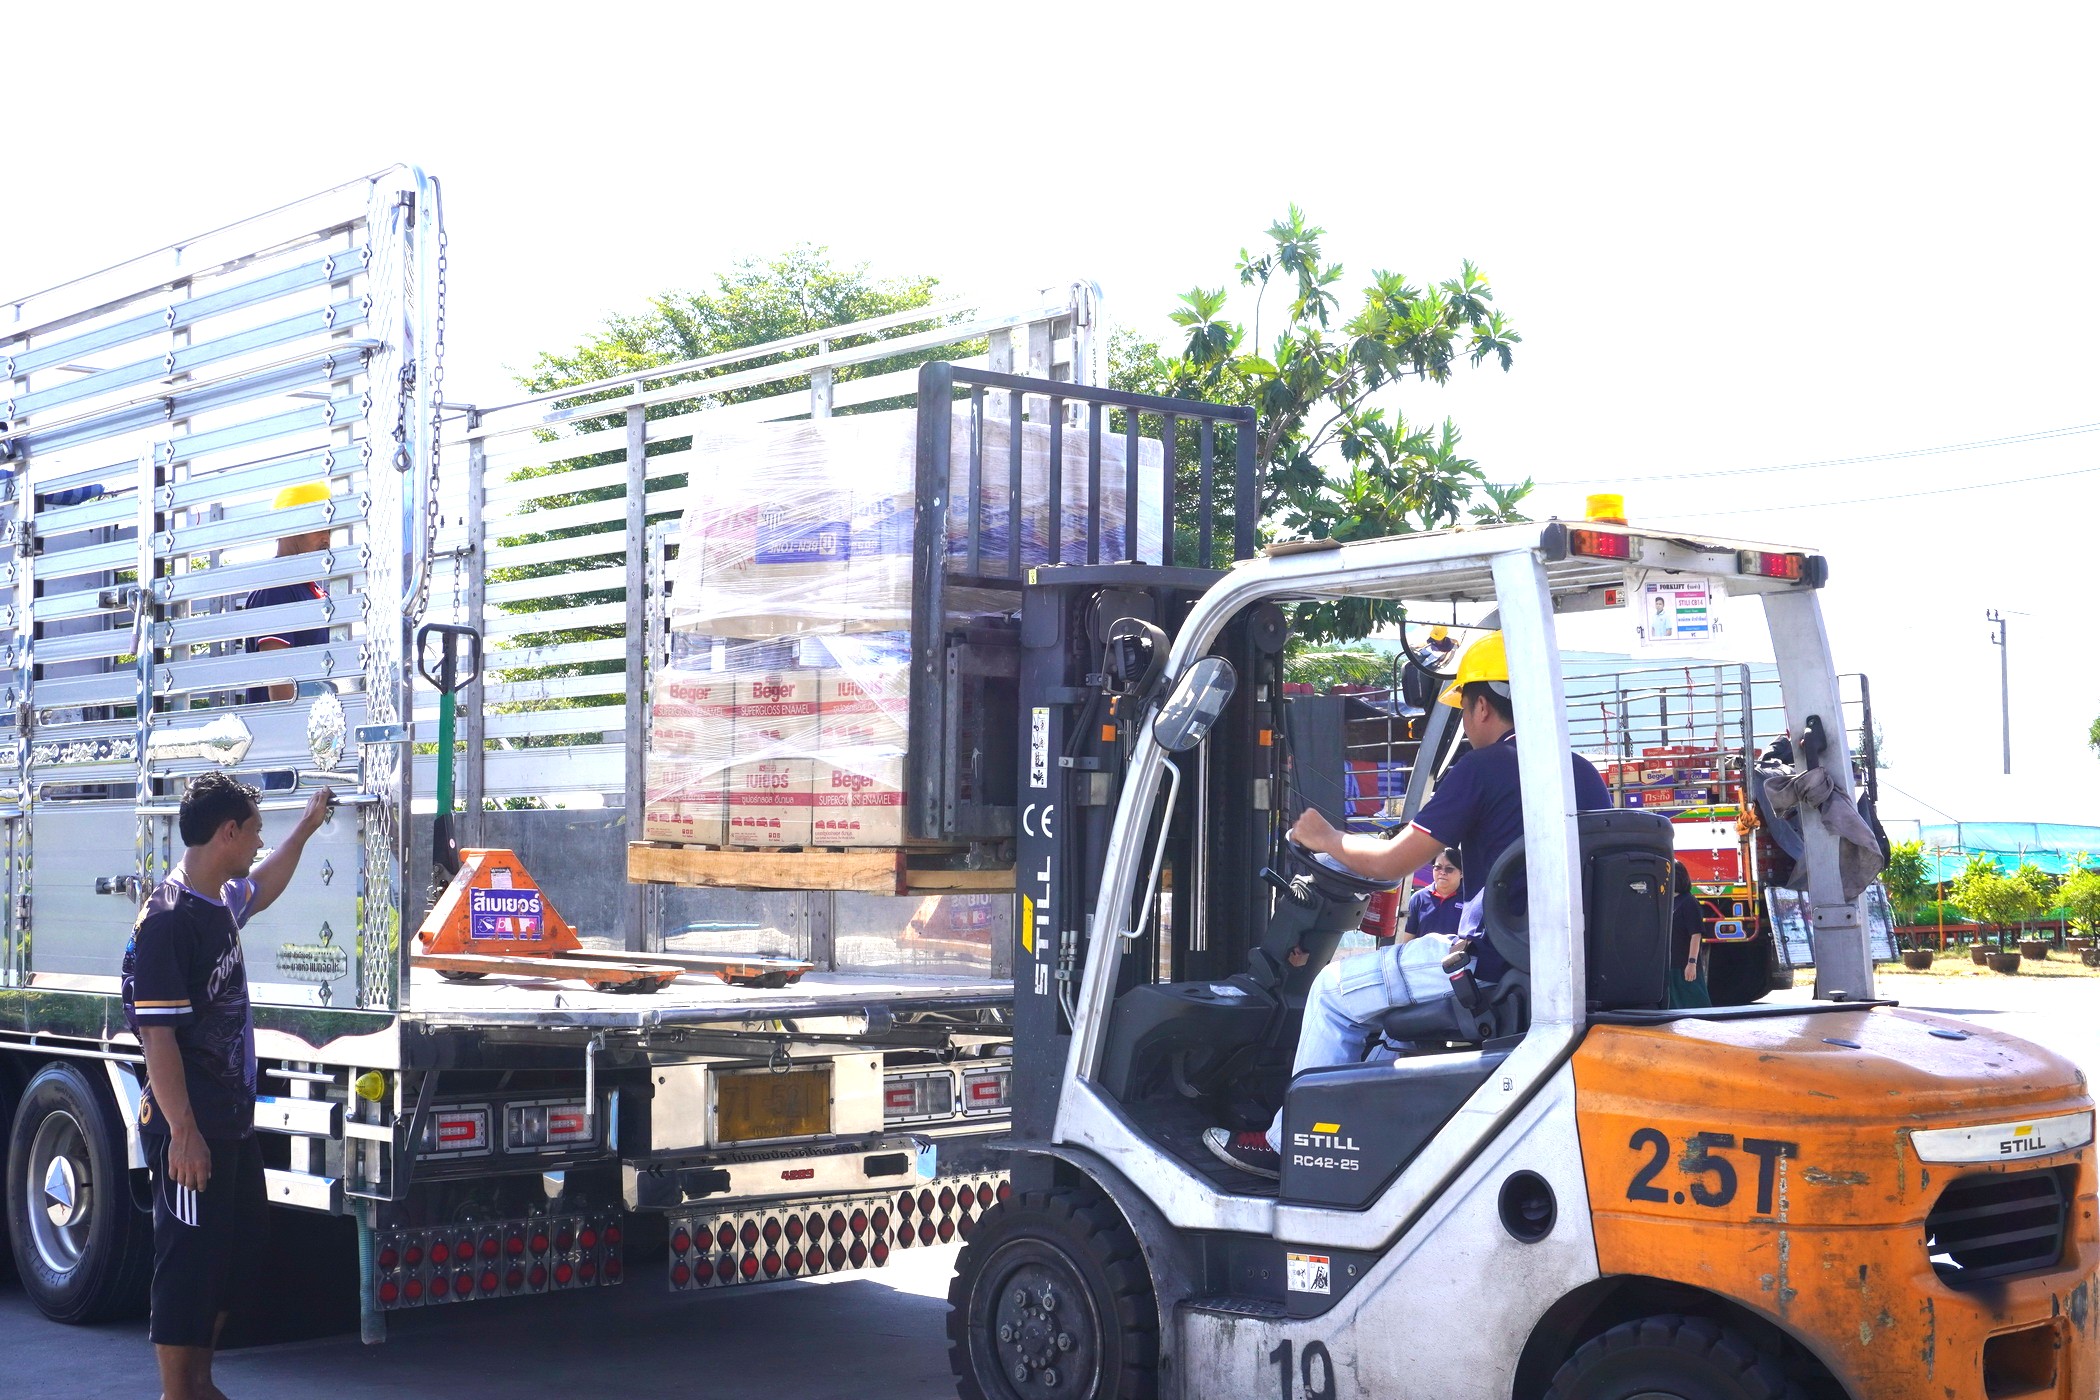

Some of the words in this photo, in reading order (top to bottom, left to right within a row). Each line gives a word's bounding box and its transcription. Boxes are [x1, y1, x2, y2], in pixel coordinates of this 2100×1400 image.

[670, 684, 711, 704] Beger
[753, 682, 795, 702] Beger
[741, 705, 780, 716] SUPERGLOSS
[782, 704, 809, 715] ENAMEL
[1647, 773, 1666, 781] Beger
[862, 794, 891, 805] ENAMEL
[473, 891, 540, 913] สีเบเยอร์
[1034, 855, 1051, 996] STILL
[1293, 1133, 1360, 1151] STILL
[2000, 1136, 2047, 1154] STILL
[1293, 1154, 1360, 1171] RC42-25
[1626, 1127, 1800, 1215] 2.5T
